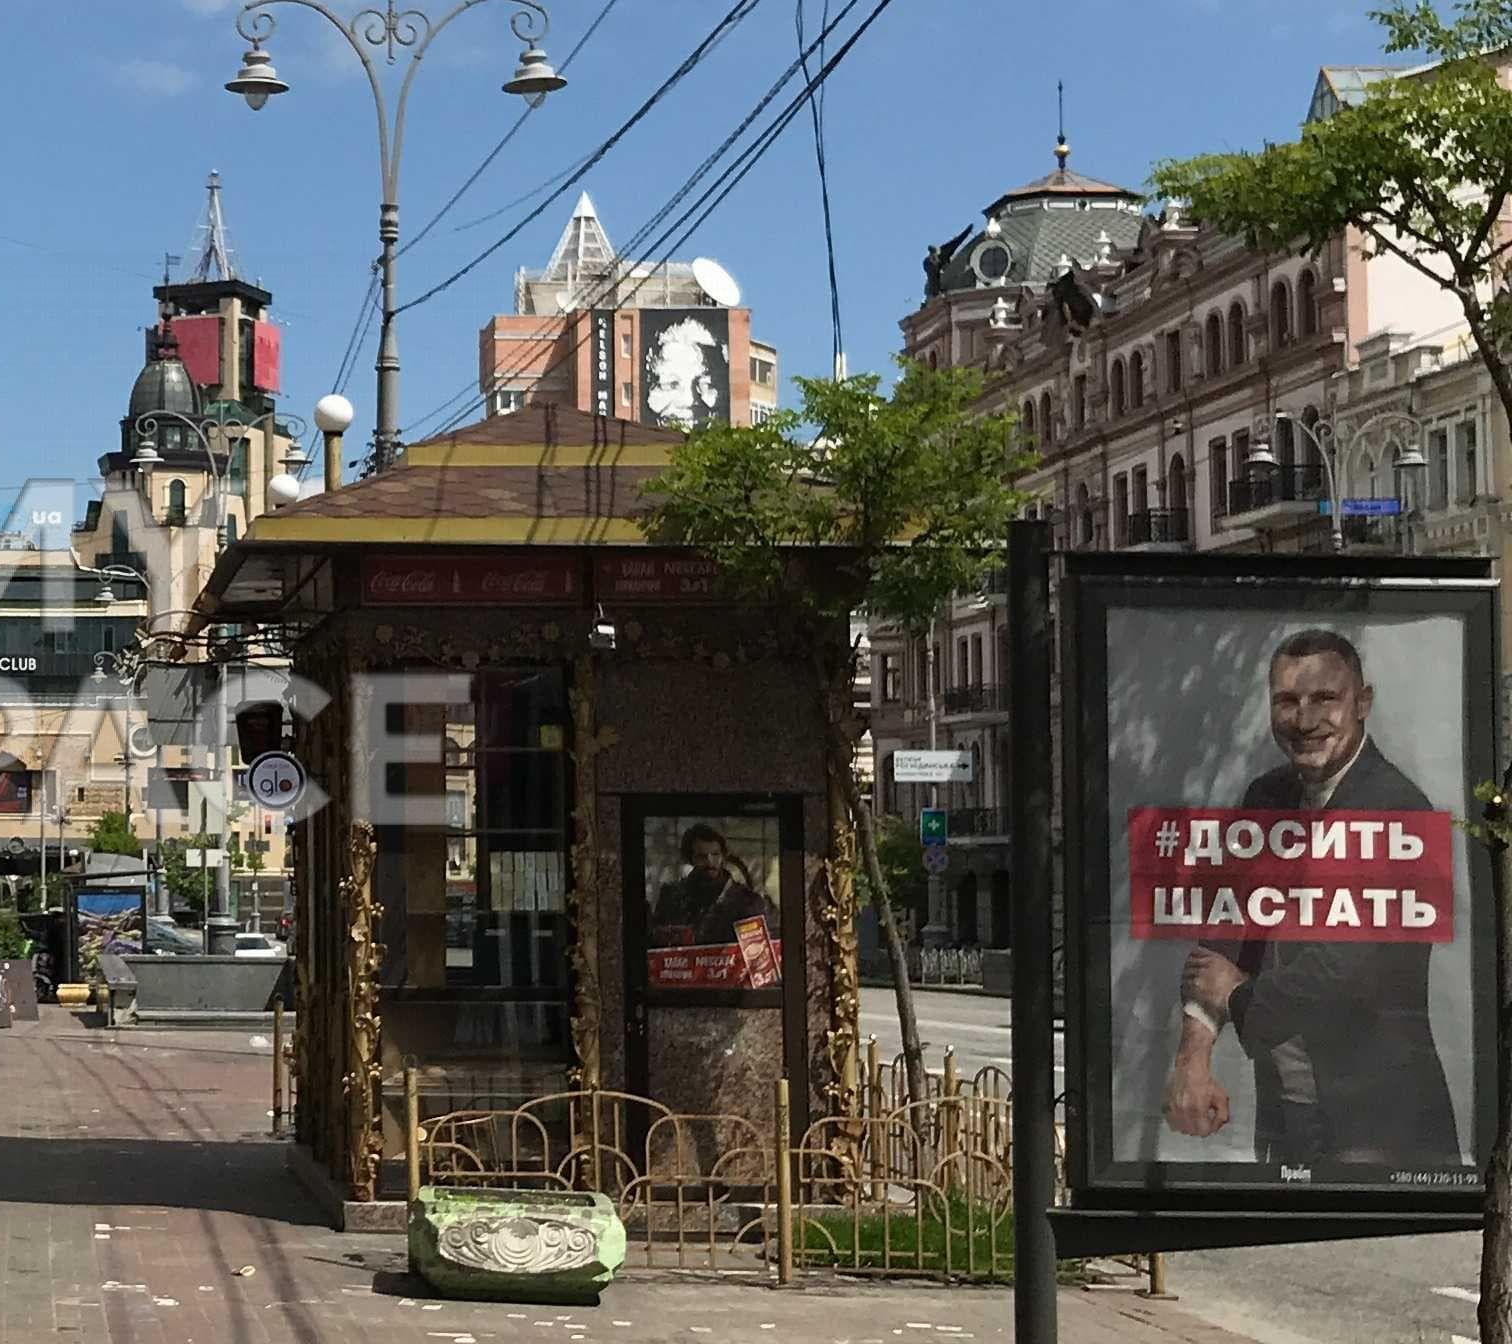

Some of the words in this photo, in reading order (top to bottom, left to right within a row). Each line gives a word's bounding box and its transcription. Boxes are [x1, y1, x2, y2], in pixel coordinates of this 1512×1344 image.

[259, 769, 293, 798] glo
[1154, 818, 1425, 867] #ДОСИТЬ
[1153, 886, 1438, 928] ШАСТАТЬ
